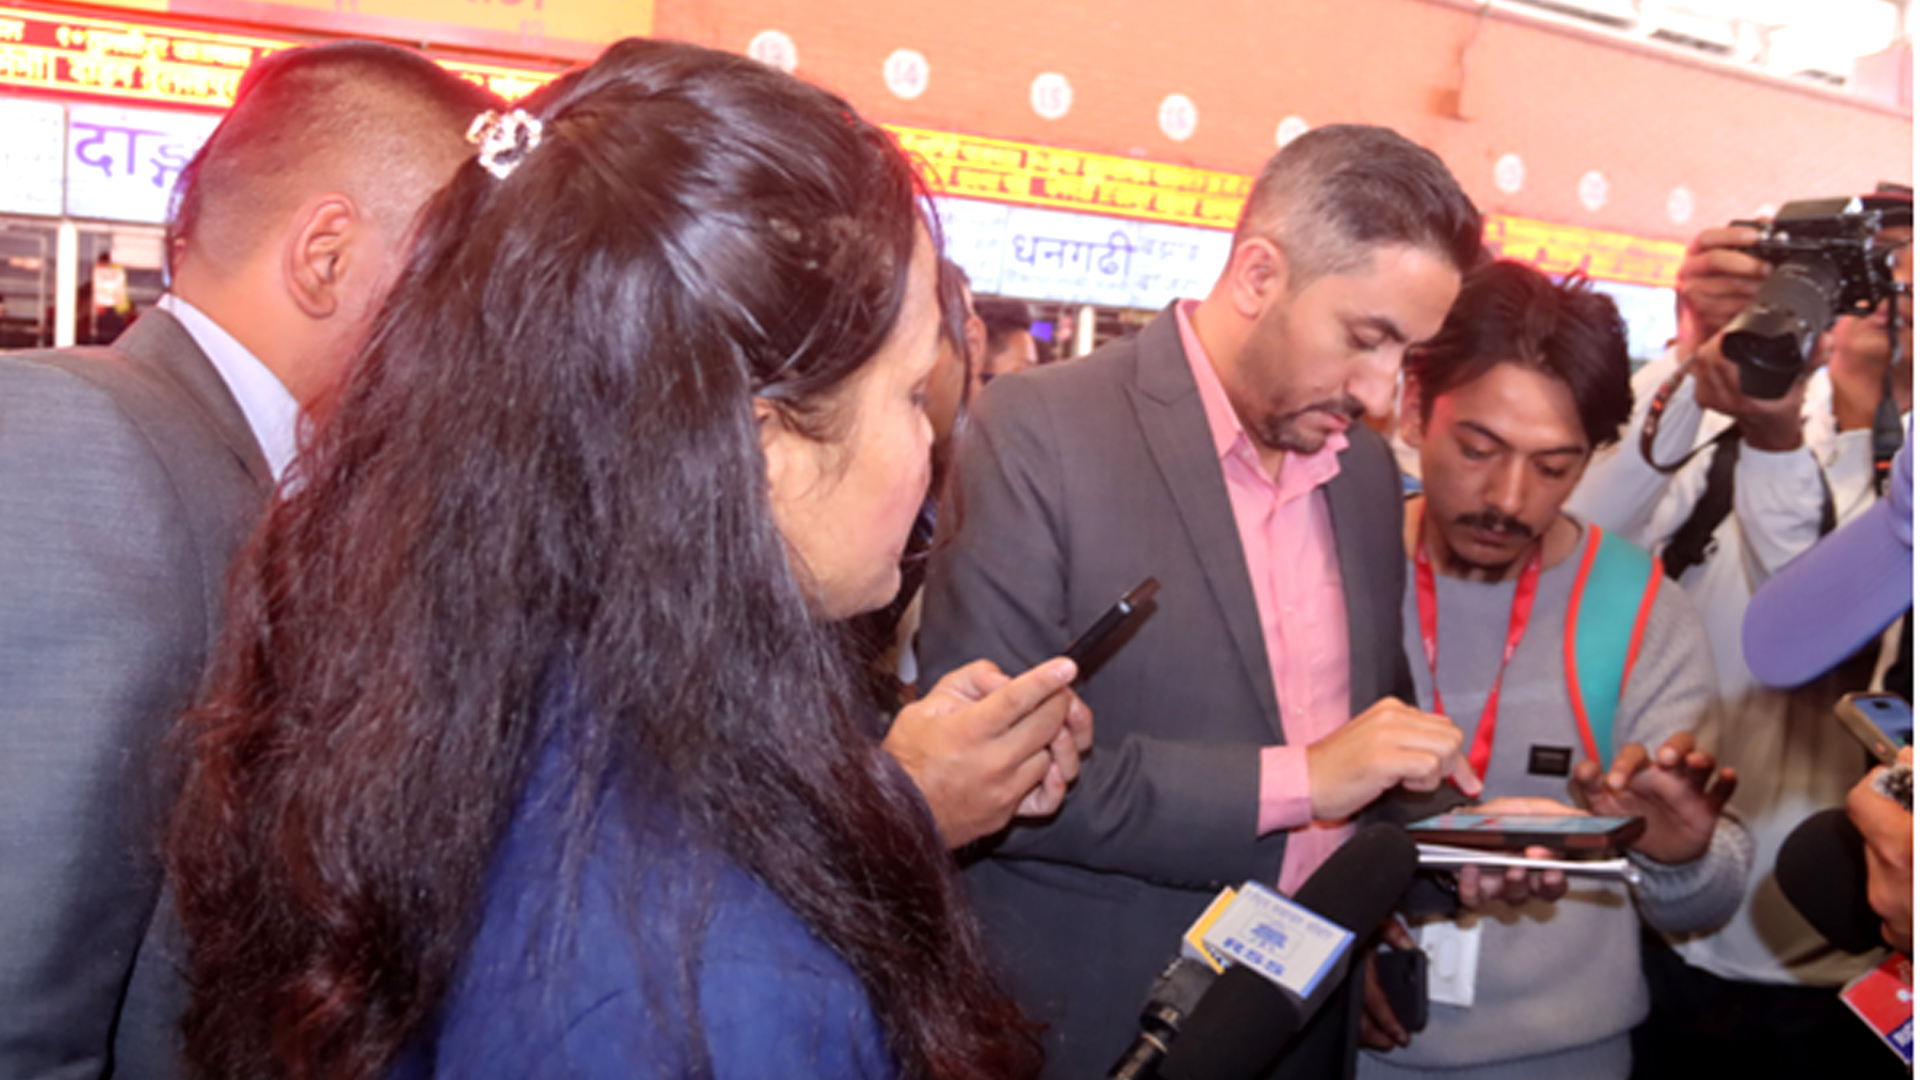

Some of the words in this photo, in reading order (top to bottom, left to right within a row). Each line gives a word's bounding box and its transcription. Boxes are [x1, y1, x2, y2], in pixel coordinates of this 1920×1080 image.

[892, 60, 918, 86] 14
[1039, 86, 1062, 110] 15
[1165, 105, 1188, 129] 16
[1011, 228, 1137, 278] धनगढी
